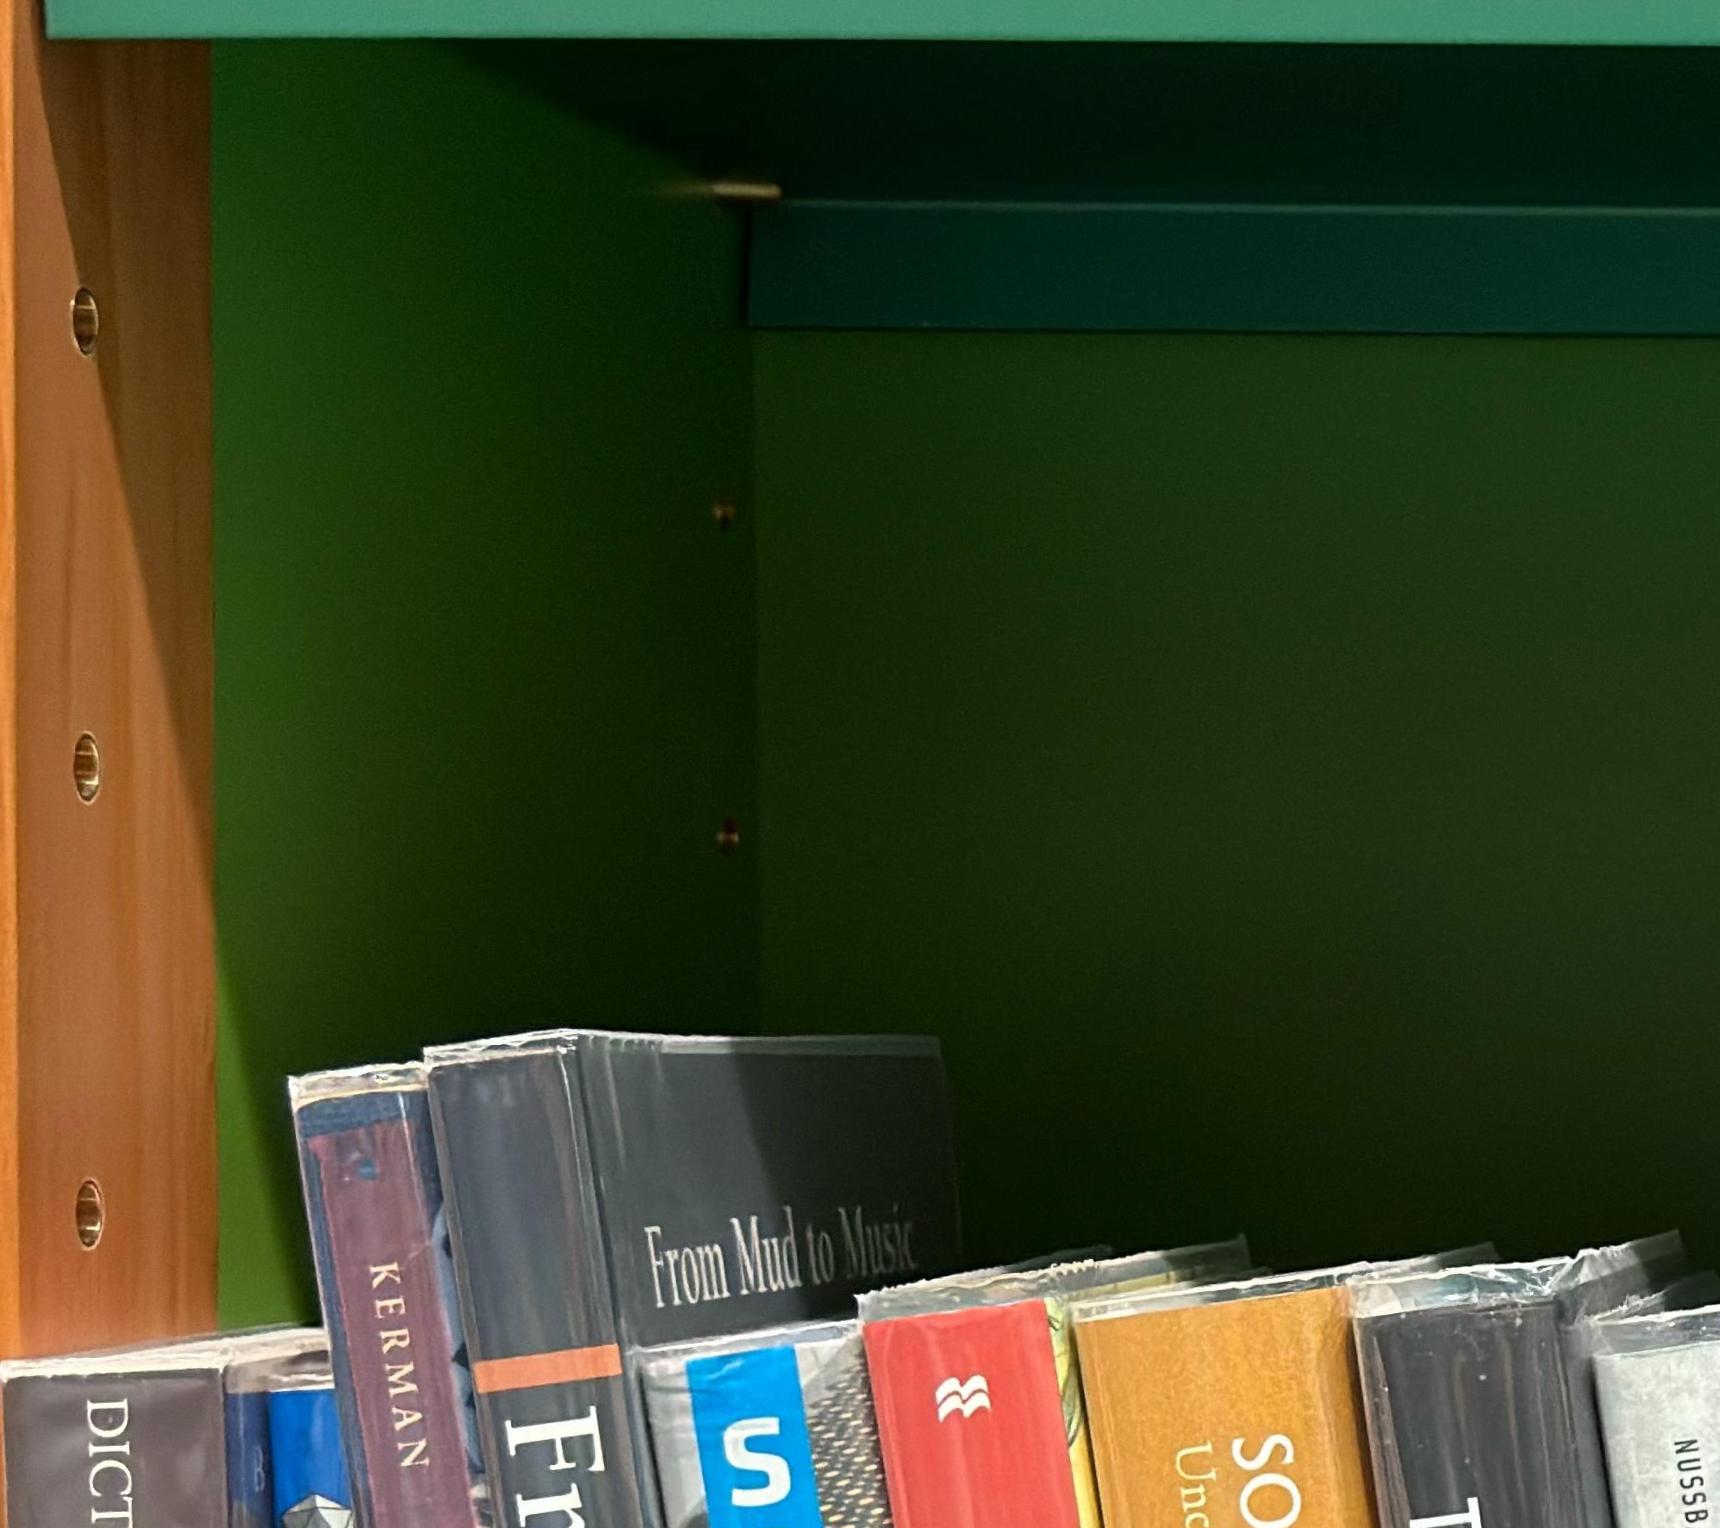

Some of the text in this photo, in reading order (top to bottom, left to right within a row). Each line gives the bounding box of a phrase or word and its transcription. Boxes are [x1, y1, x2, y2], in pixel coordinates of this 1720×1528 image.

[644, 1203, 918, 1308] From Mud to Music
[368, 1262, 428, 1468] KERMAN
